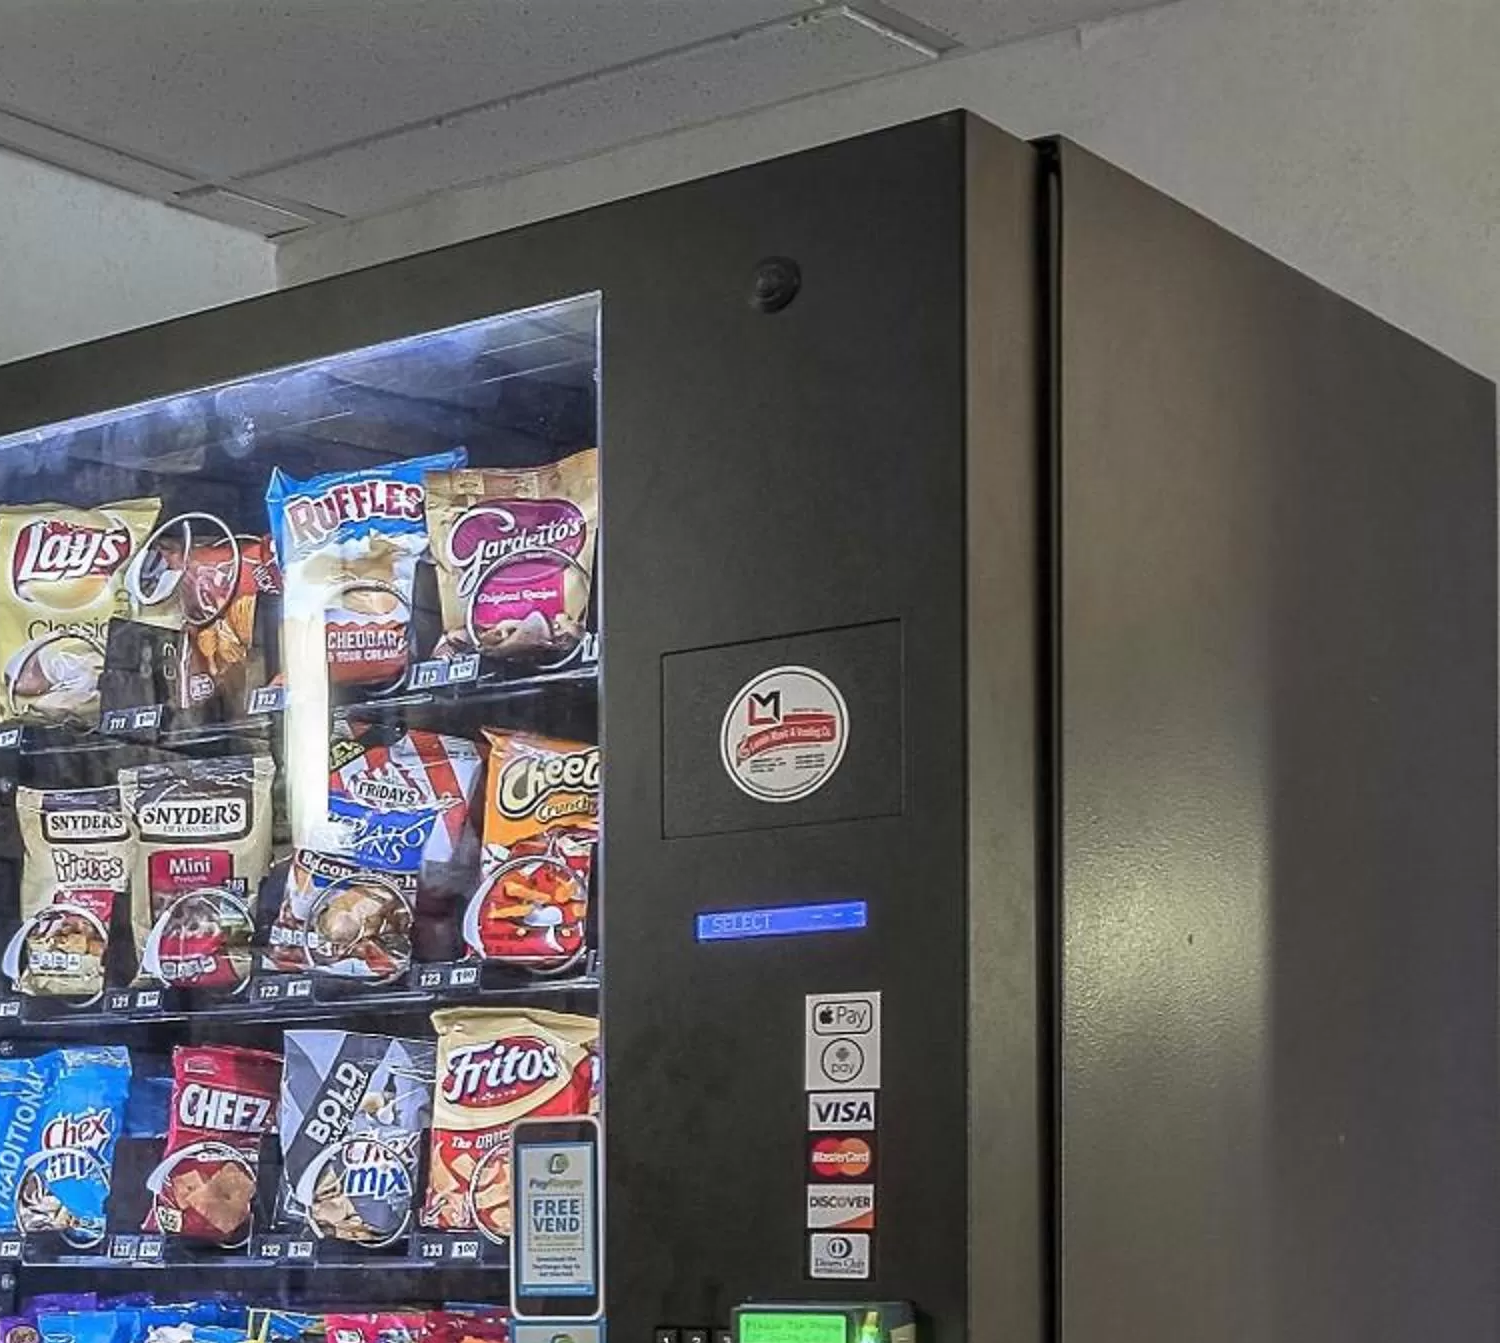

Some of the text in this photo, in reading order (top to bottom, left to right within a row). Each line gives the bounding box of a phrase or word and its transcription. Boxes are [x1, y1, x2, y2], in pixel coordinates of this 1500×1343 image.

[287, 480, 424, 547] RUFFLES
[327, 631, 397, 649] CHEDDAR
[142, 802, 242, 825] SNYDER'S
[169, 857, 212, 876] Mini
[711, 913, 773, 933] SELECT
[420, 972, 440, 986] 123
[260, 985, 279, 998] 122
[836, 1005, 868, 1029] Pay
[444, 1042, 558, 1102] Fritos
[179, 1083, 271, 1133] CHEEZ
[304, 1061, 359, 1146] BOLD
[814, 1101, 873, 1123] VISA
[43, 1106, 112, 1150] Chex
[346, 1166, 408, 1198] mix
[533, 1199, 581, 1216] FREE
[809, 1195, 871, 1208] DISCOVER
[533, 1217, 581, 1233] VEND
